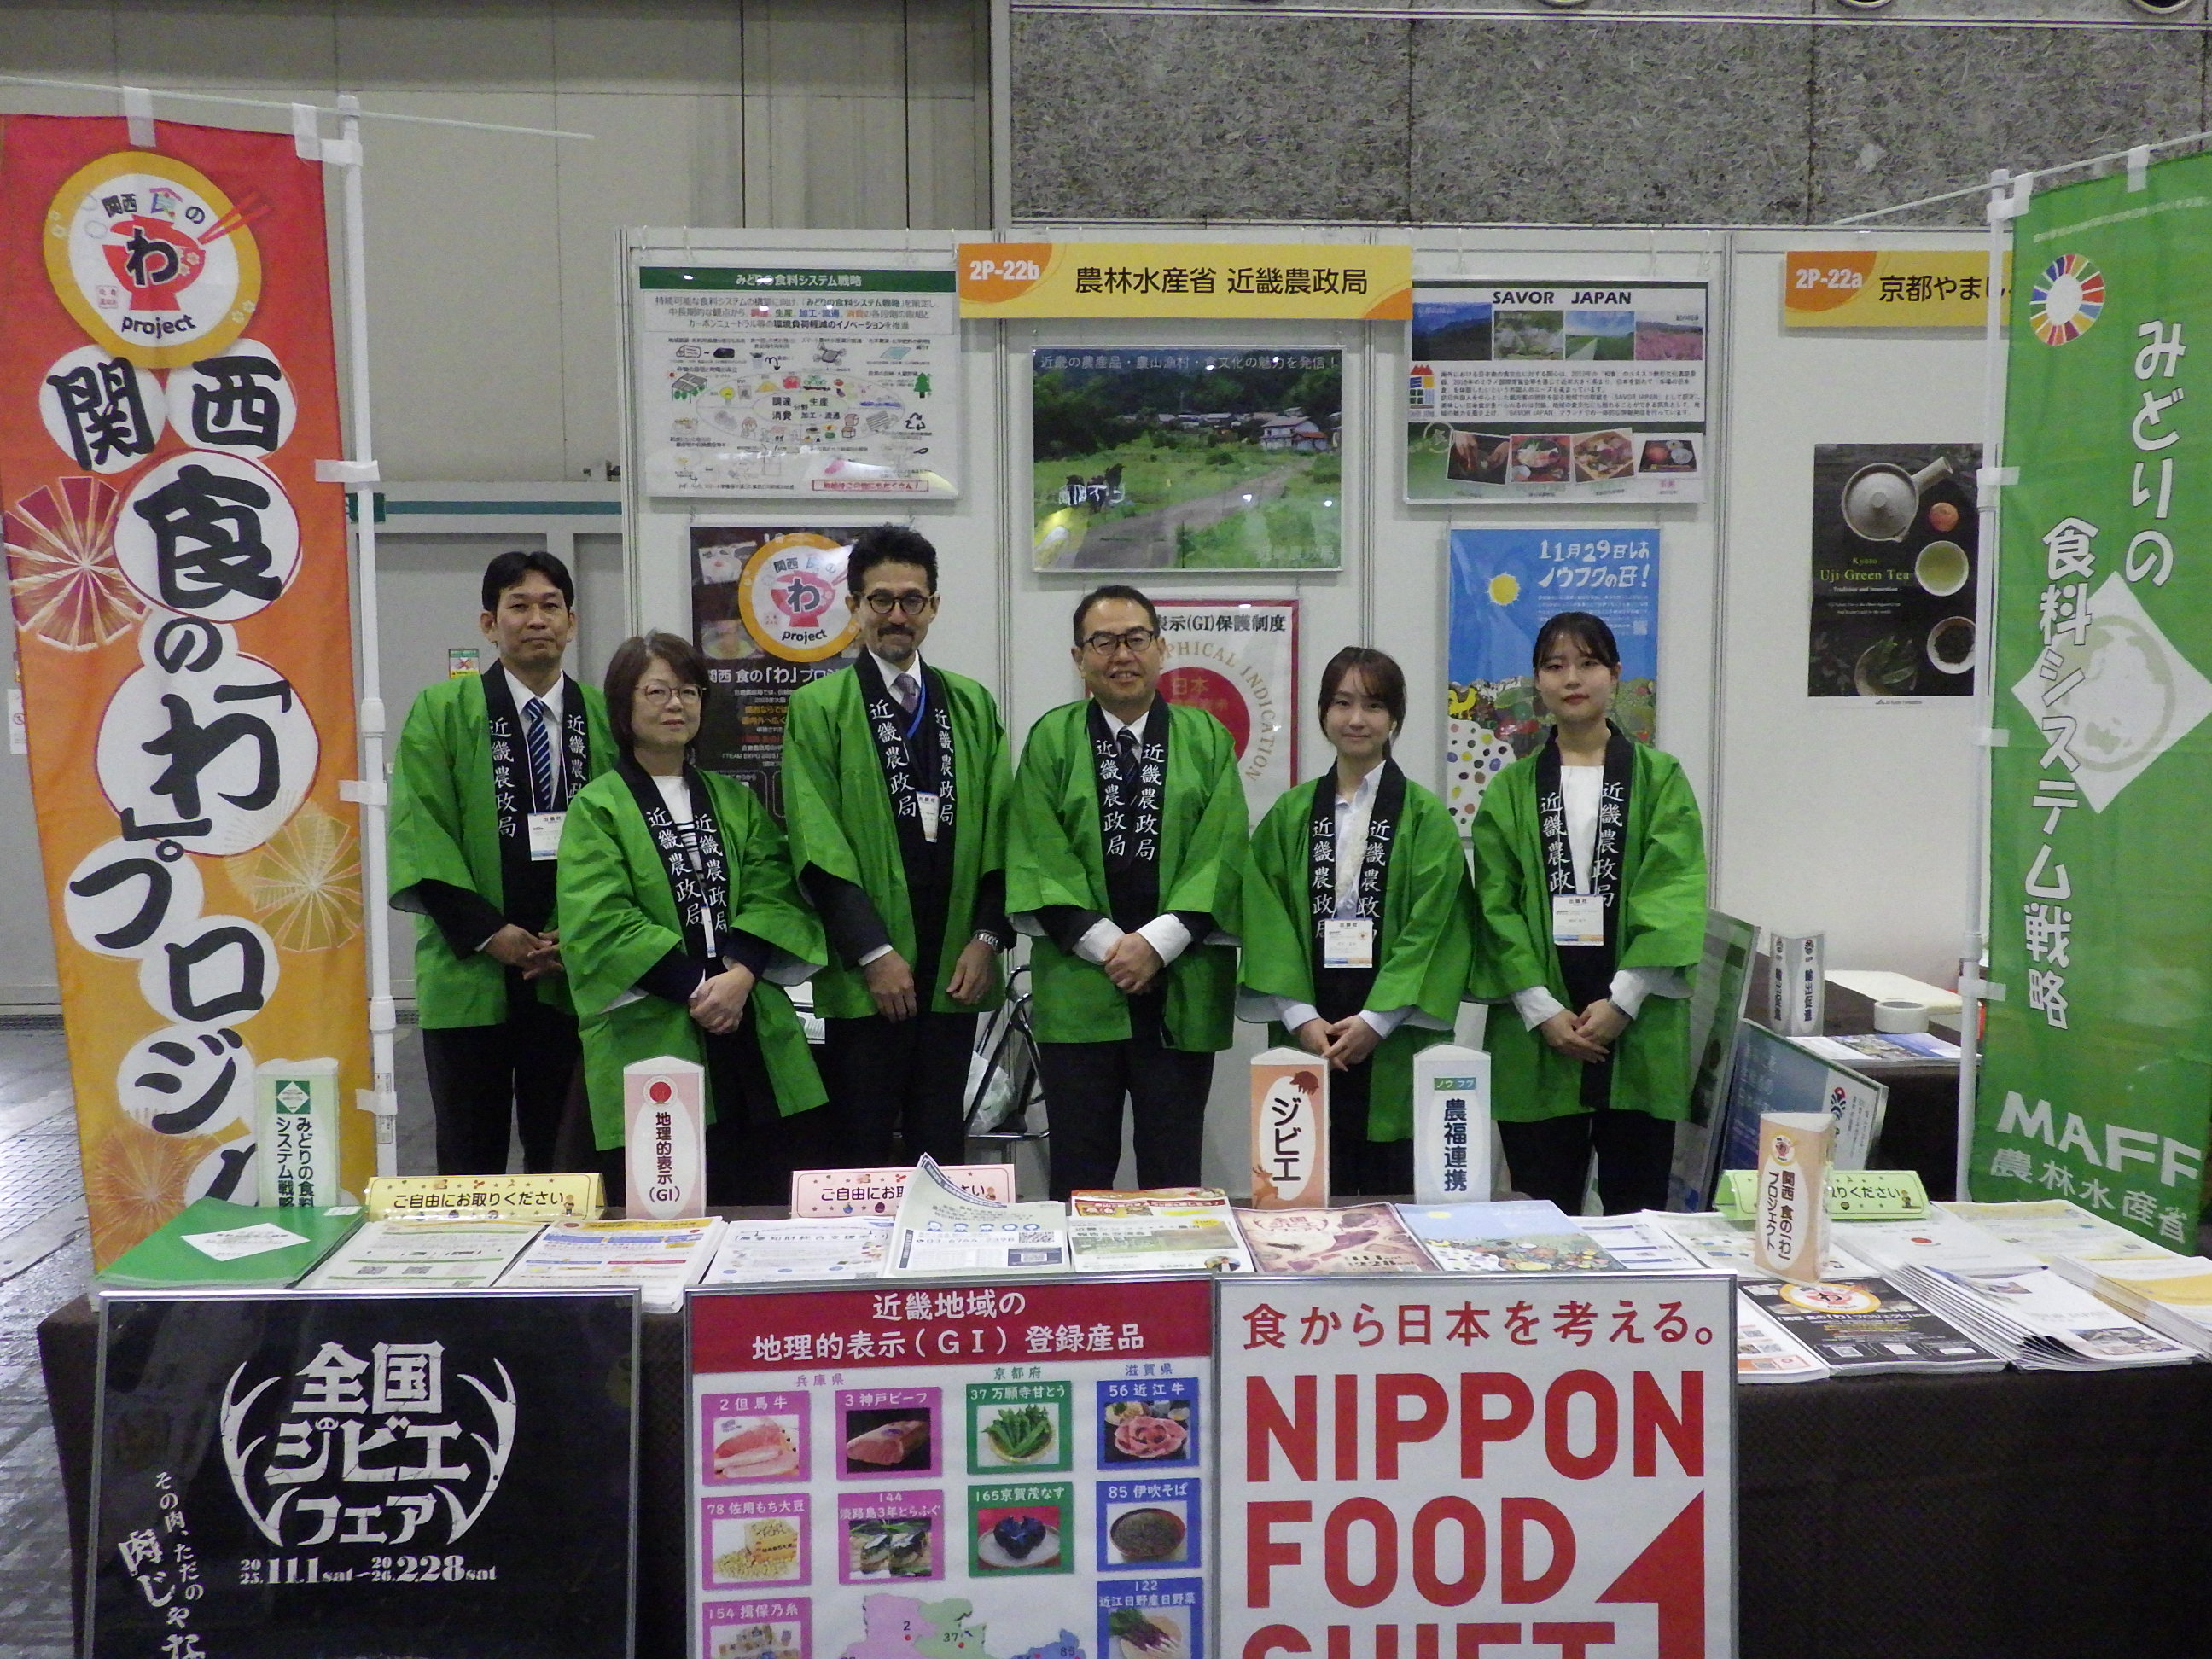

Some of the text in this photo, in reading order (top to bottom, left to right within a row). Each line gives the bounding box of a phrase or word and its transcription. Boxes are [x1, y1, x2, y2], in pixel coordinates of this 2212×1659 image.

[126, 227, 179, 287] わ
[969, 260, 1039, 281] 2P-22b
[1075, 266, 1368, 295] 農林水産省 近畿農政局
[1796, 268, 1863, 289] 2P-22a
[1493, 291, 1632, 305] SAVOR JAPAN
[121, 312, 197, 340] project
[809, 397, 828, 407] 生産
[2125, 319, 2186, 588] みどりの
[1539, 539, 1649, 562] 11月29日は
[1820, 569, 1910, 583] Uji Green Tea
[787, 578, 820, 613] わ
[782, 629, 828, 645] project
[1239, 665, 1277, 782] INDICATION
[870, 698, 917, 818] 近畿農政局
[934, 707, 956, 826] 近畿農政局
[2023, 516, 2100, 1030] 食料システム戦略
[489, 716, 517, 839] 近畿農政局
[1096, 739, 1127, 857] 近畿農政局
[1135, 743, 1166, 861] 近畿農政局
[1540, 792, 1575, 893] 近畿農政
[1591, 782, 1625, 908] 近畿農政局
[646, 807, 703, 928] 近畿農政局
[694, 813, 728, 933] 近畿農政局
[1436, 1080, 1474, 1088] ノウフク
[655, 1112, 672, 1185] 地理的表示
[1272, 1097, 1301, 1182] ジビエ
[1444, 1098, 1468, 1192] 農福連携
[1996, 1091, 2202, 1187] MAFF
[393, 1191, 563, 1208] ご自由にお取りください
[649, 1187, 681, 1203] (GI)
[1990, 1148, 2187, 1244] 農林水産省
[1766, 1172, 1779, 1251] プロジェクト
[872, 1289, 1026, 1321] 近畿地域の
[1242, 1300, 1714, 1351] 食から日本を考える。
[292, 1340, 445, 1415] 全国
[795, 1373, 844, 1388] 兵庫県
[993, 1366, 1042, 1381] 京都府
[1125, 1363, 1173, 1377] 滋賀県
[719, 1395, 788, 1412] 2 但馬牛
[845, 1392, 928, 1407] 3 神戸ビーフ
[970, 1383, 1066, 1400] 37 万願寺甘とう
[1109, 1382, 1185, 1399] 56 近江牛
[1247, 1369, 1704, 1483] NIPPON
[264, 1417, 472, 1486] ジビエ
[707, 1499, 805, 1515] 78 佐用もち大豆
[879, 1493, 903, 1503] 144
[1109, 1483, 1188, 1499] 85 伊吹そば
[296, 1492, 437, 1546] フェア
[1247, 1495, 1576, 1609] FOOD
[1135, 1580, 1158, 1591] 122
[708, 1603, 799, 1619] 154 揖保乃糸
[904, 1621, 911, 1631] 2
[943, 1632, 958, 1643] 37
